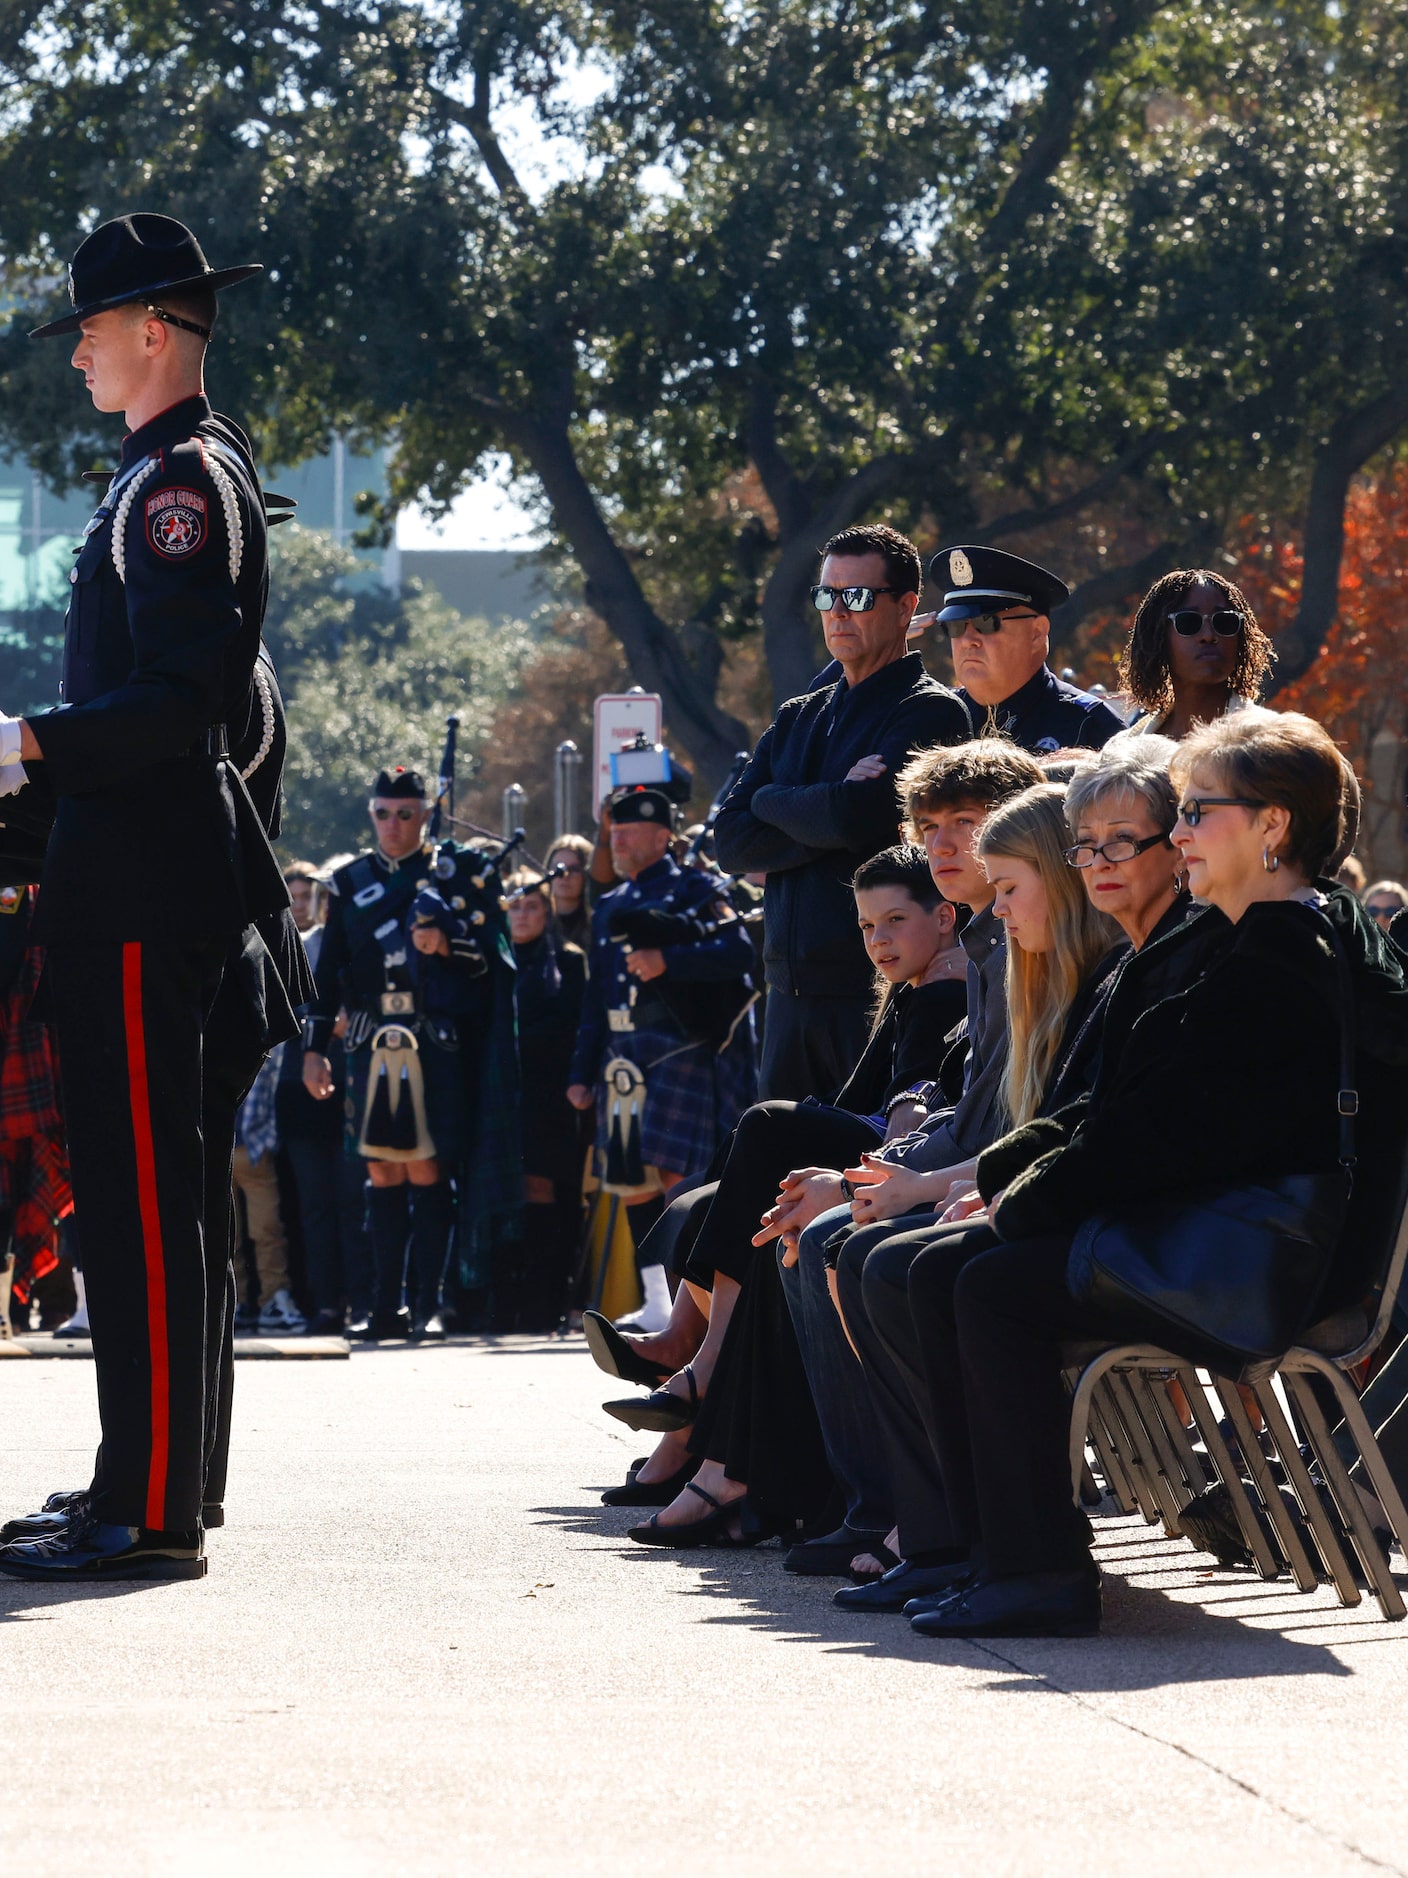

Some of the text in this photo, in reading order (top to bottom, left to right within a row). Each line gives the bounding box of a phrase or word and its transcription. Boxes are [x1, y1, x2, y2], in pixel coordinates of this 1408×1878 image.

[147, 490, 205, 516] HONOR GUARD
[158, 509, 194, 524] LEWISVILLE
[165, 543, 189, 551] POLICE
